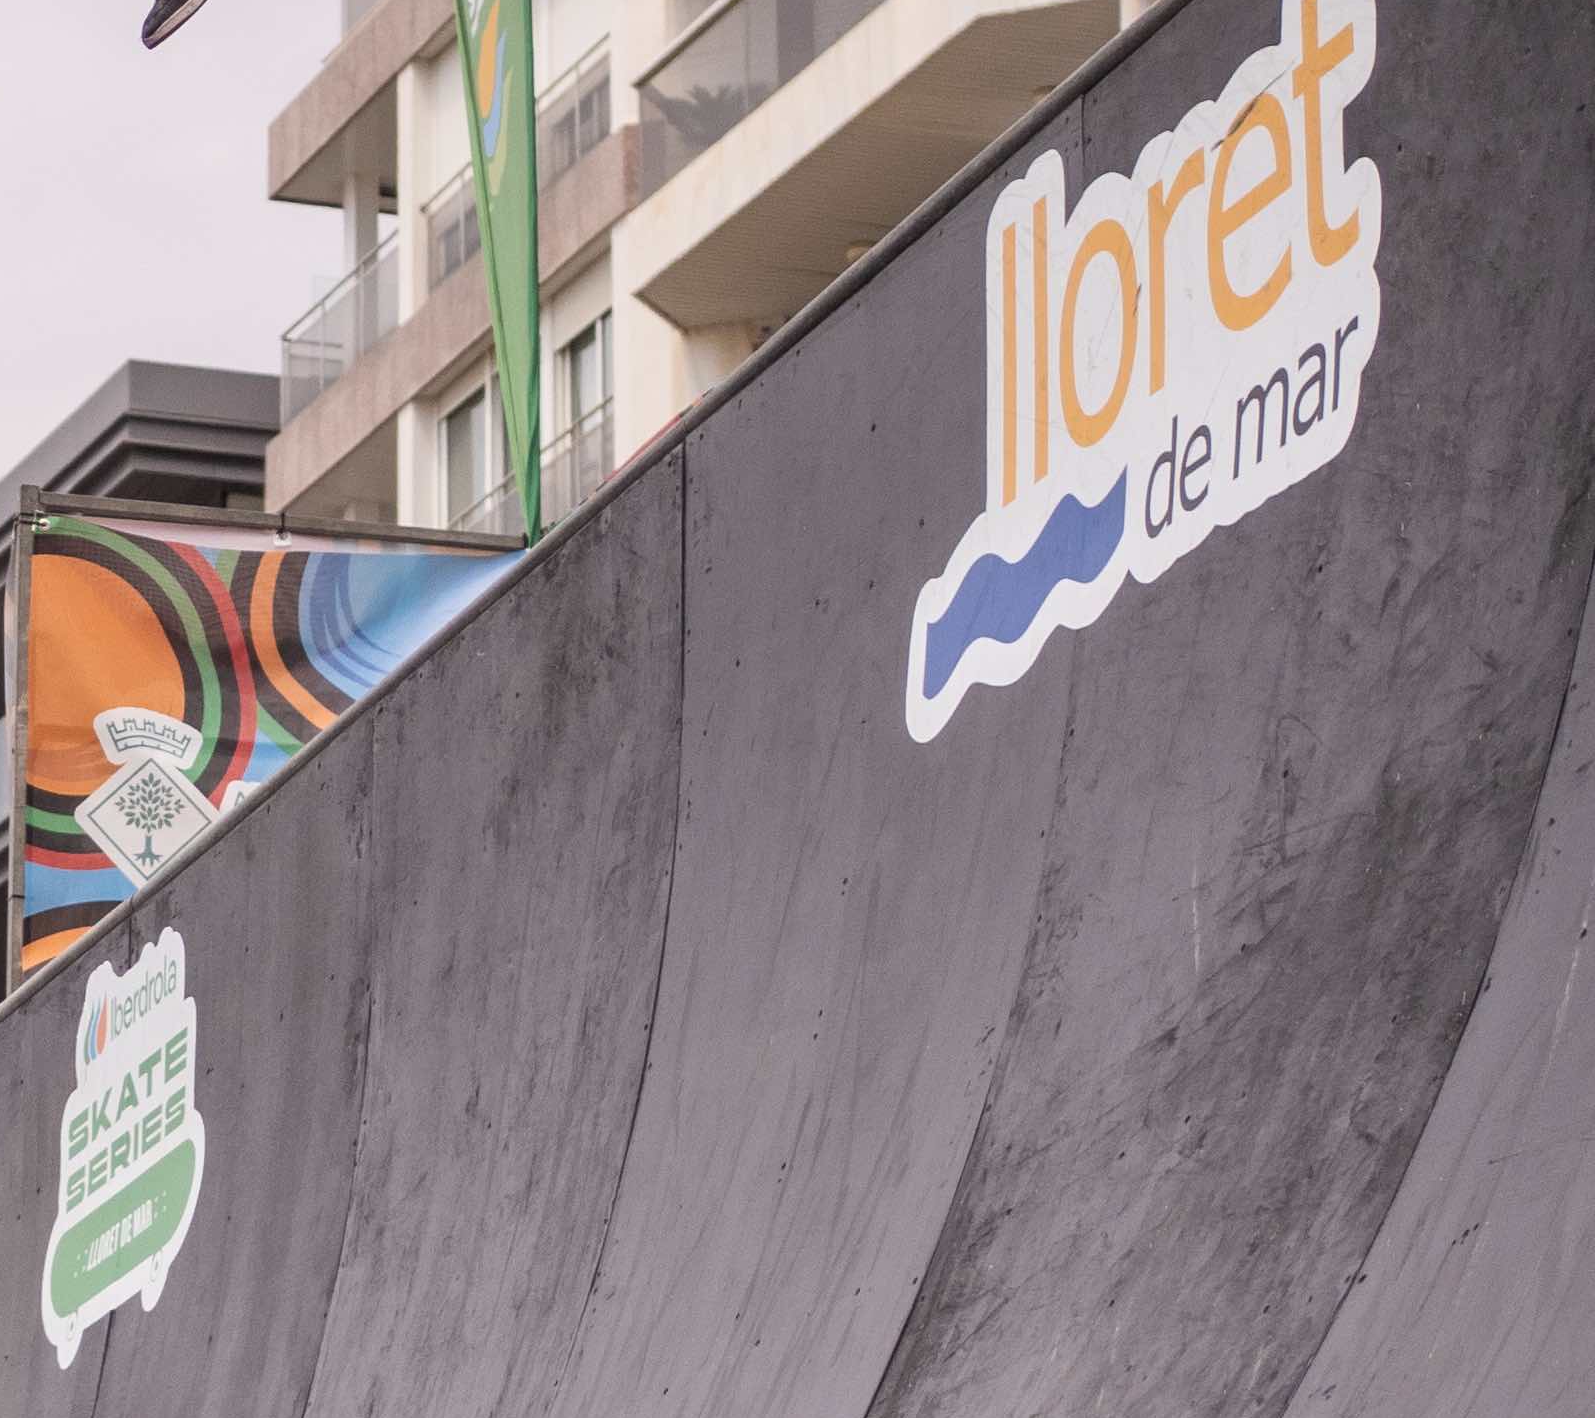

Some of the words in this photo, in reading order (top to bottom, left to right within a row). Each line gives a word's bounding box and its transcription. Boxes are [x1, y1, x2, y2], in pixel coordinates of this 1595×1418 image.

[1145, 415, 1209, 539] de
[1233, 316, 1359, 481] mar
[110, 955, 177, 1041] Iberdrola
[66, 1085, 186, 1214] SERIES
[68, 1027, 188, 1160] SKATE
